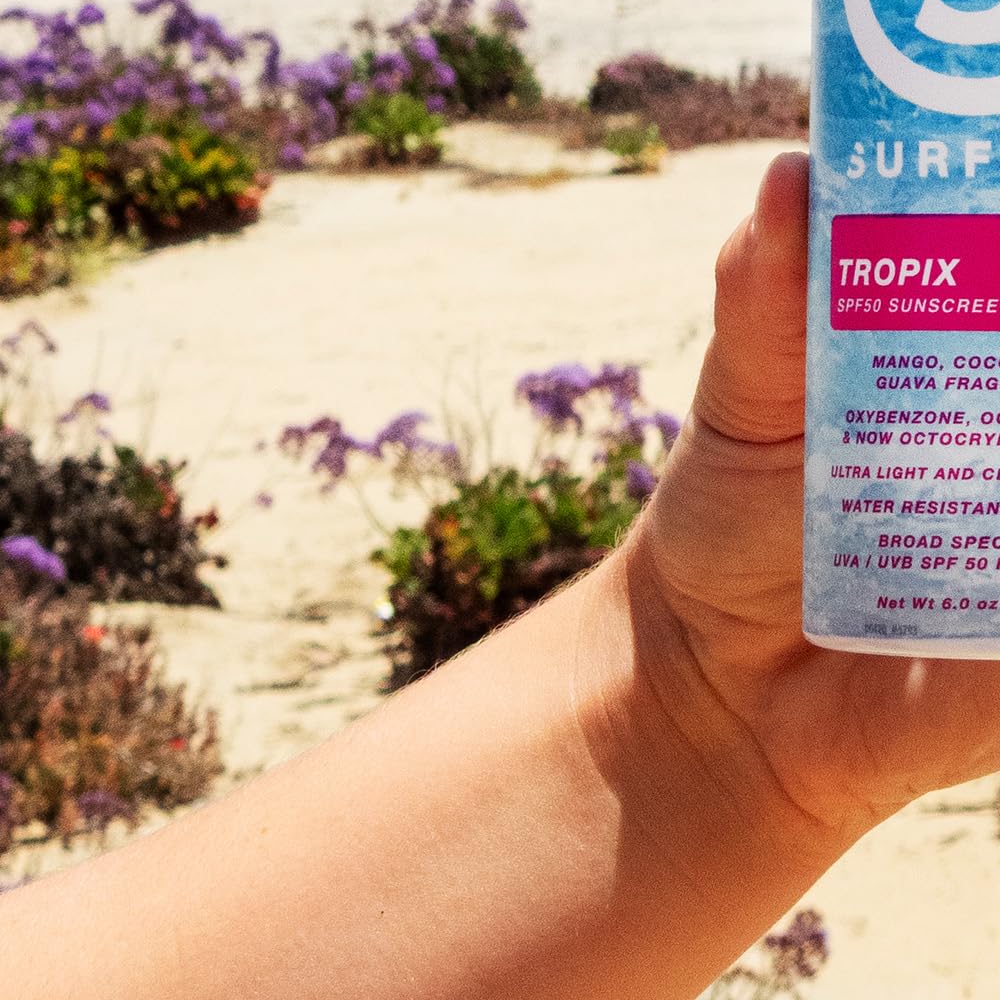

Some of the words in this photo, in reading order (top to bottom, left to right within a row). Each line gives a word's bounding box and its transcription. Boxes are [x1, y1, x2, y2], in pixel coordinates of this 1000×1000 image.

[839, 258, 961, 286] TROPIX
[837, 298, 881, 313] SPF50
[872, 355, 945, 371] MANGO,
[876, 376, 937, 391] GUAVA
[845, 410, 971, 427] OXYBENZONE,
[842, 431, 851, 445] &
[855, 432, 893, 445] NOW
[830, 465, 871, 480] ULTRA
[876, 466, 928, 480] LIGHT
[933, 467, 974, 481] AND
[842, 499, 894, 514] WATER
[878, 534, 943, 549] BROAD
[833, 555, 860, 568] UVA
[877, 556, 914, 570] UVB
[920, 556, 957, 571] SPF
[964, 556, 989, 571] 50
[876, 596, 905, 610] Net
[911, 597, 936, 610] Wt
[941, 597, 970, 611] 6.0
[979, 600, 998, 611] oz
